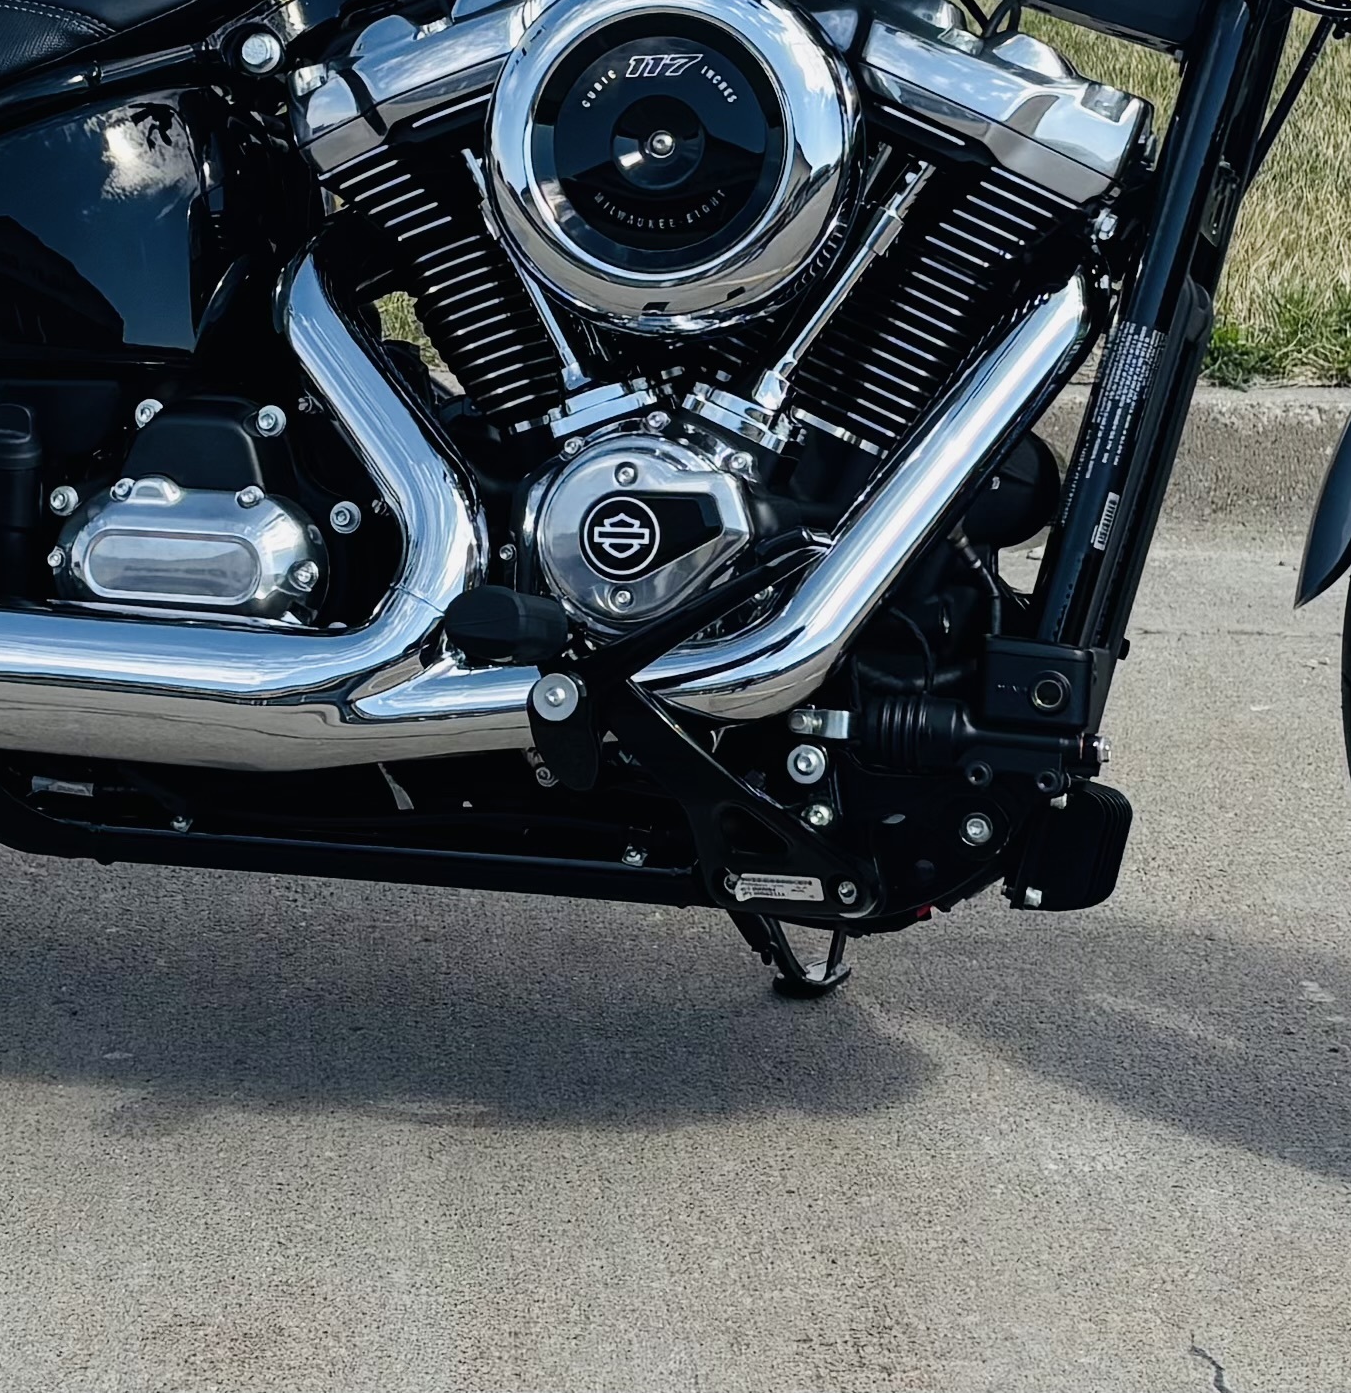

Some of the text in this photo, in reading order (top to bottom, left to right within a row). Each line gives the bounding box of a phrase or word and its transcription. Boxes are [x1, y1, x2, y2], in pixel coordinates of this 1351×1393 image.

[581, 53, 738, 108] CUBIC 117 INCHES
[594, 189, 727, 229] MILWAUKEE-EIGHT
